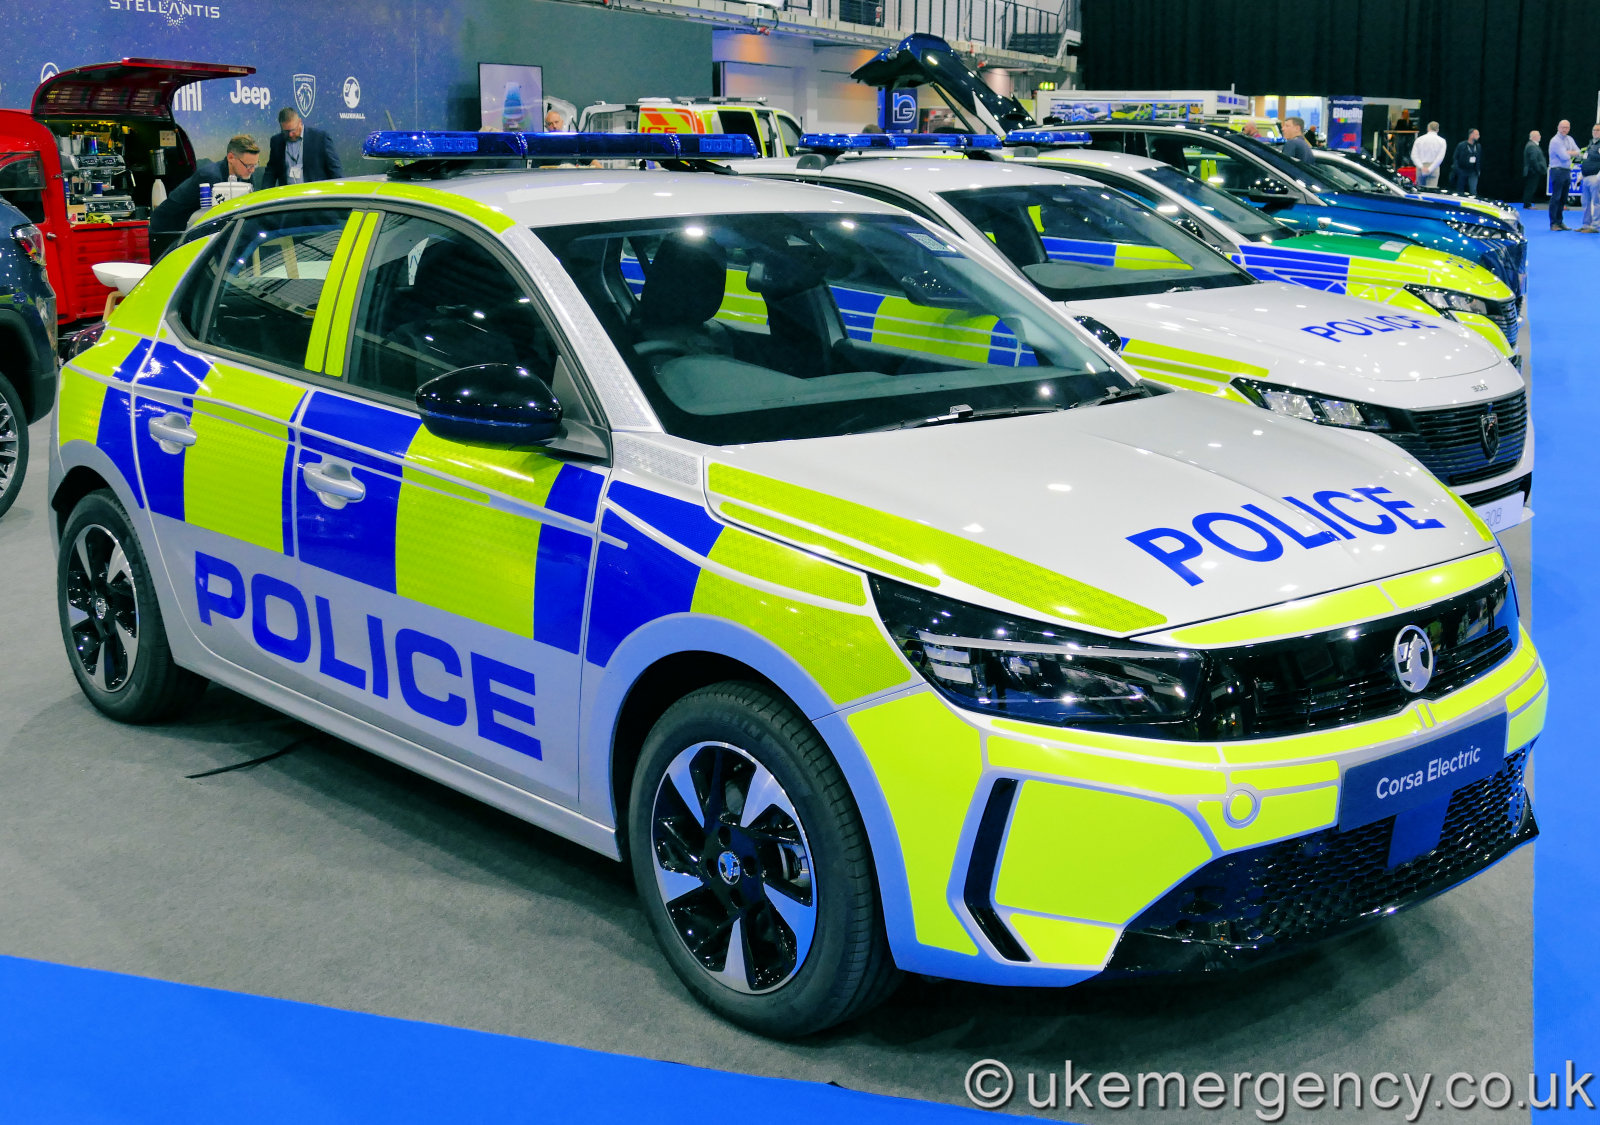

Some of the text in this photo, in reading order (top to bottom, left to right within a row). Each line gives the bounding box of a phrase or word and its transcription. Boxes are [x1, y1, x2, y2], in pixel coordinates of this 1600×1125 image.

[110, 0, 220, 19] STELLANTIS
[229, 79, 270, 110] Jeep
[1300, 315, 1441, 342] POLICE
[1125, 486, 1446, 587] POLICE
[195, 550, 543, 761] POLICE
[1376, 745, 1481, 800] Corsa Electric
